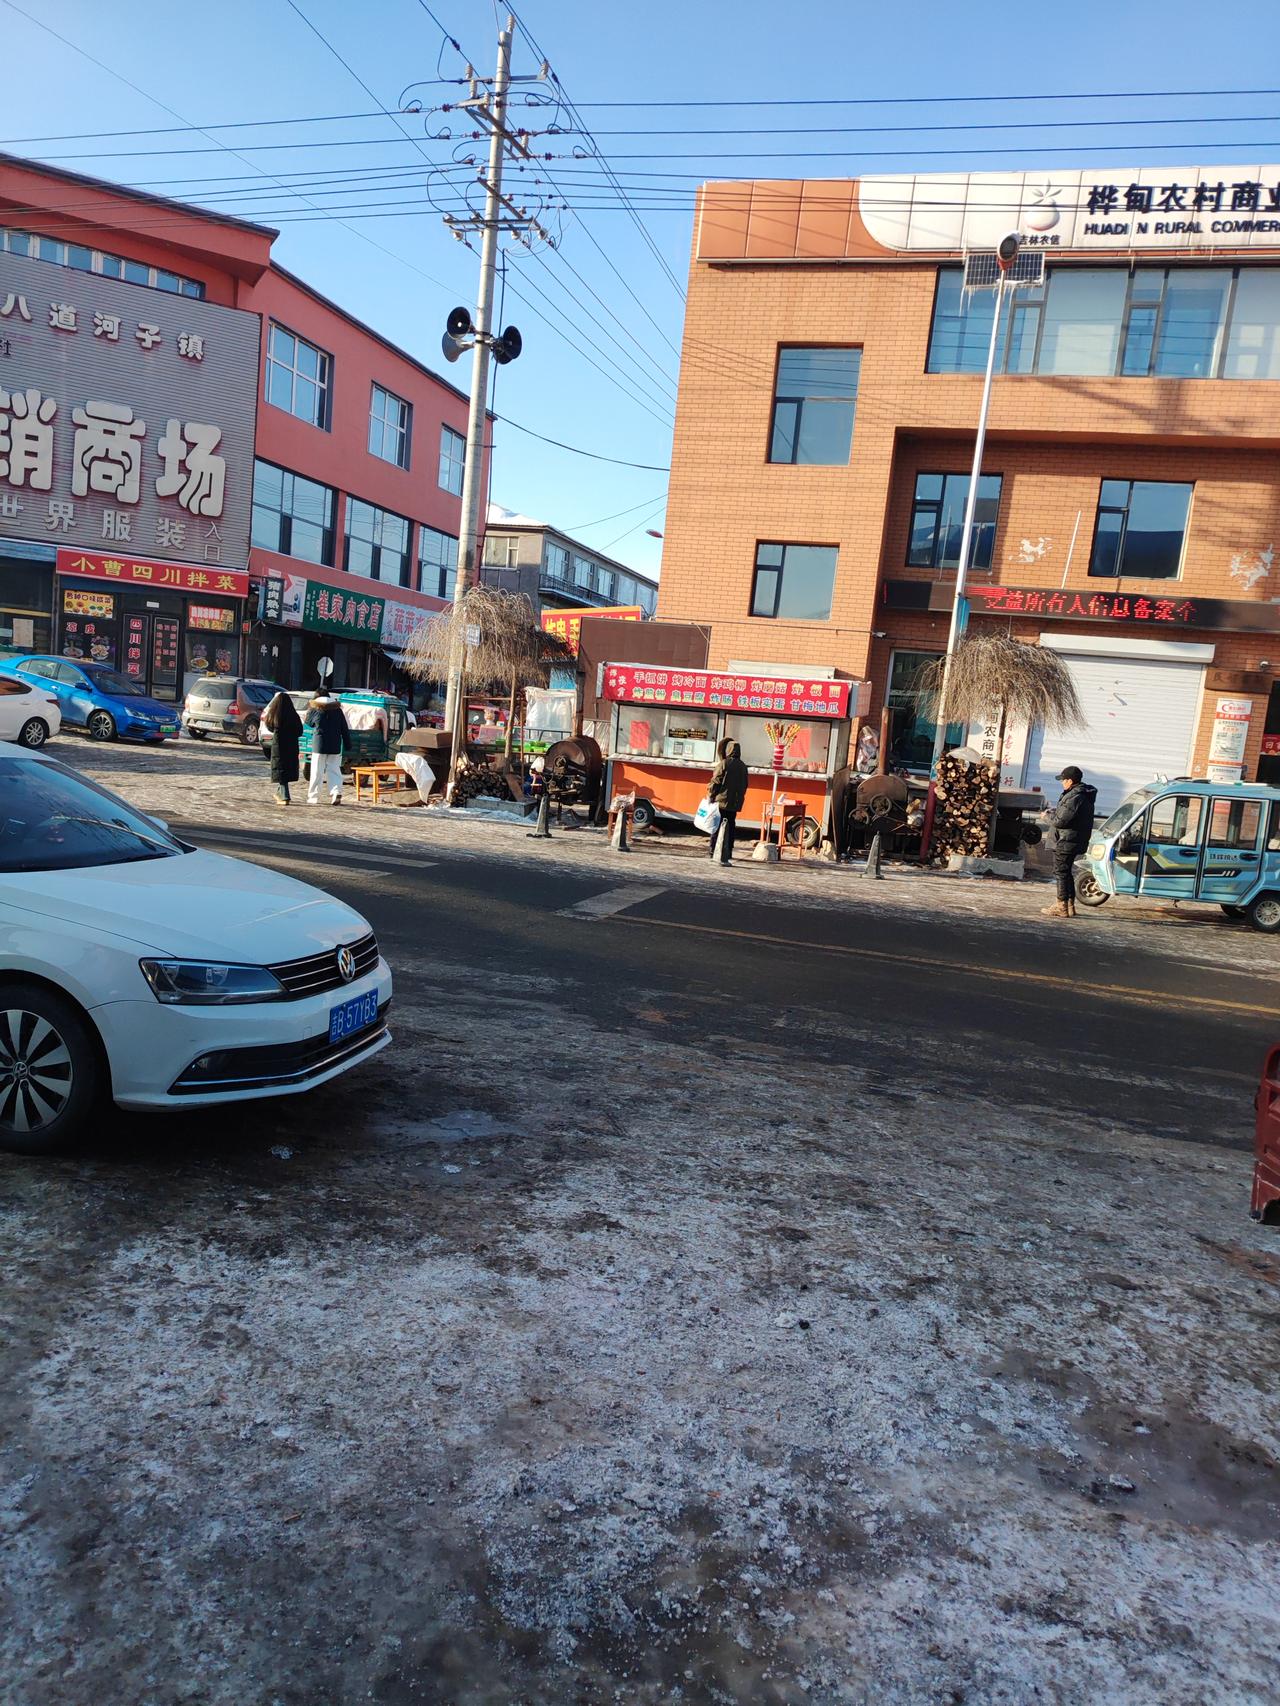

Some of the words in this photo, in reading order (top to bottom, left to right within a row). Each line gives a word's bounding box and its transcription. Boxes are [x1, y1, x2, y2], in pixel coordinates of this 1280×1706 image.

[1019, 234, 1060, 246] 吉林农信
[1154, 219, 1204, 234] RURAL
[1, 293, 206, 361] 八道河子镇
[0, 495, 187, 549] 世界服装
[204, 521, 222, 562] 入口
[71, 556, 237, 591] 小曹四川拌菜
[315, 589, 383, 631] 崔家肉食店
[128, 618, 142, 674] 四川拌菜
[634, 671, 668, 686] 手抓饼
[672, 674, 707, 689] 烤冷面
[790, 698, 839, 713] 甘梅地瓜
